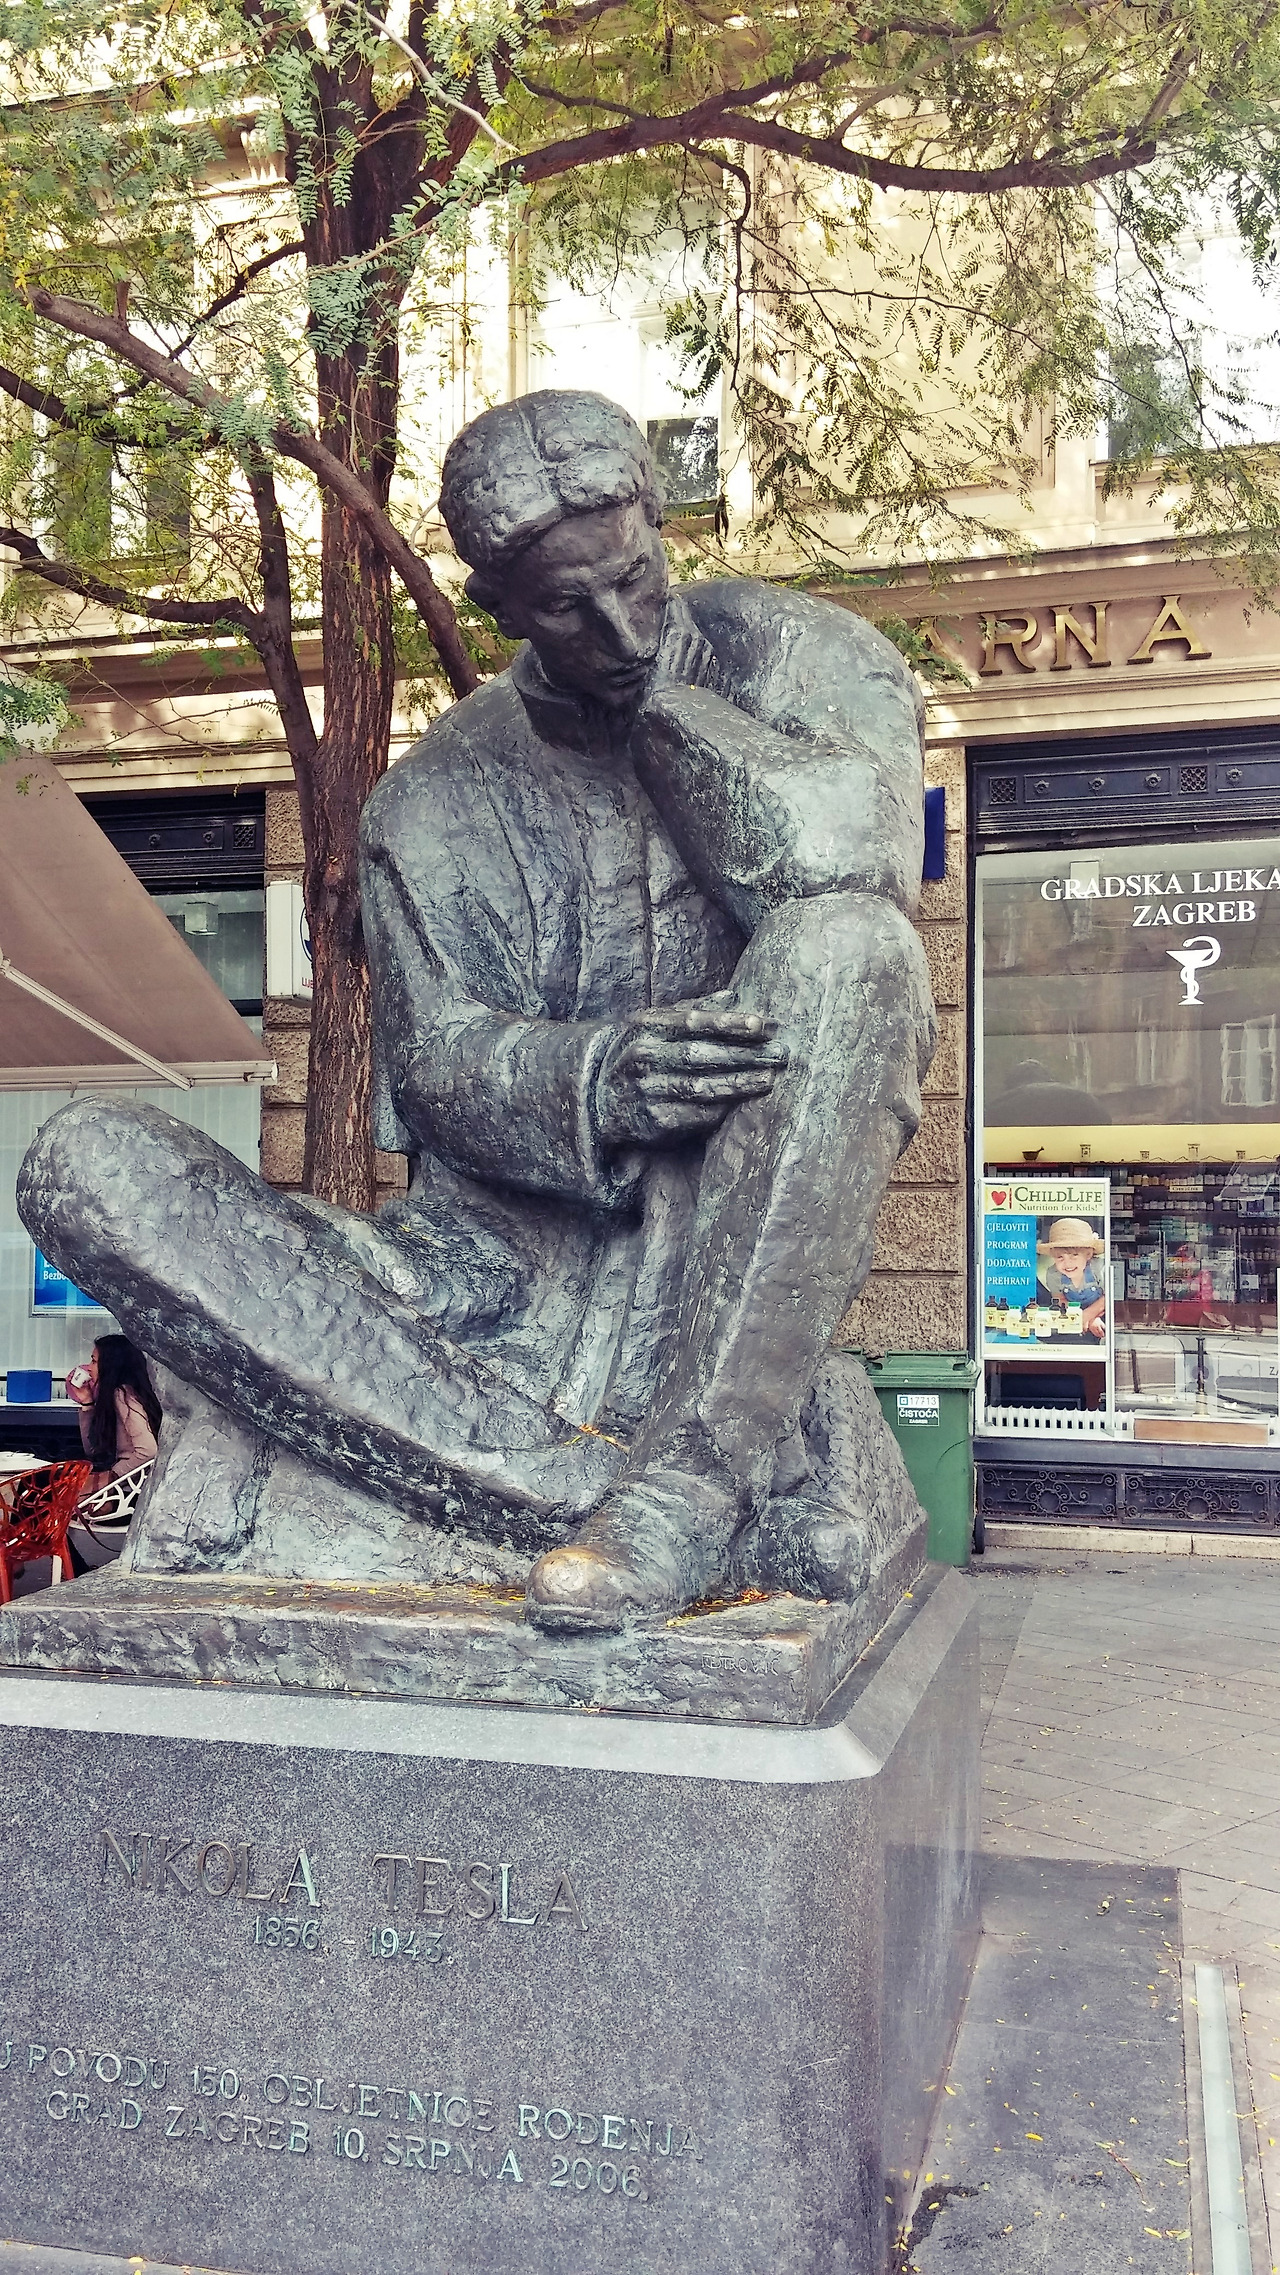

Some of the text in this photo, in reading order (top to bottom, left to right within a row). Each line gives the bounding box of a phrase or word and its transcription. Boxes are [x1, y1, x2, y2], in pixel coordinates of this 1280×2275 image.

[1040, 873, 1185, 901] GRADSKA
[1132, 900, 1257, 927] ZAGREB
[1019, 1203, 1059, 1211] Nutrition
[987, 1223, 1029, 1232] CJELOVITI
[987, 1241, 1028, 1250] PROGRAM
[987, 1258, 1031, 1267] DODATAKA
[987, 1276, 1029, 1285] PREHRANI
[910, 1396, 937, 1406] 17713
[899, 1407, 939, 1418] ČISTOĆA
[100, 1829, 589, 1932] NIKOLA TESLA
[27, 2044, 170, 2091] POVODU
[263, 2072, 495, 2132] OBLJETNICE
[46, 2090, 144, 2130] GRAD
[164, 2105, 310, 2154] ZAGREB
[382, 2134, 525, 2183] SRPNJA
